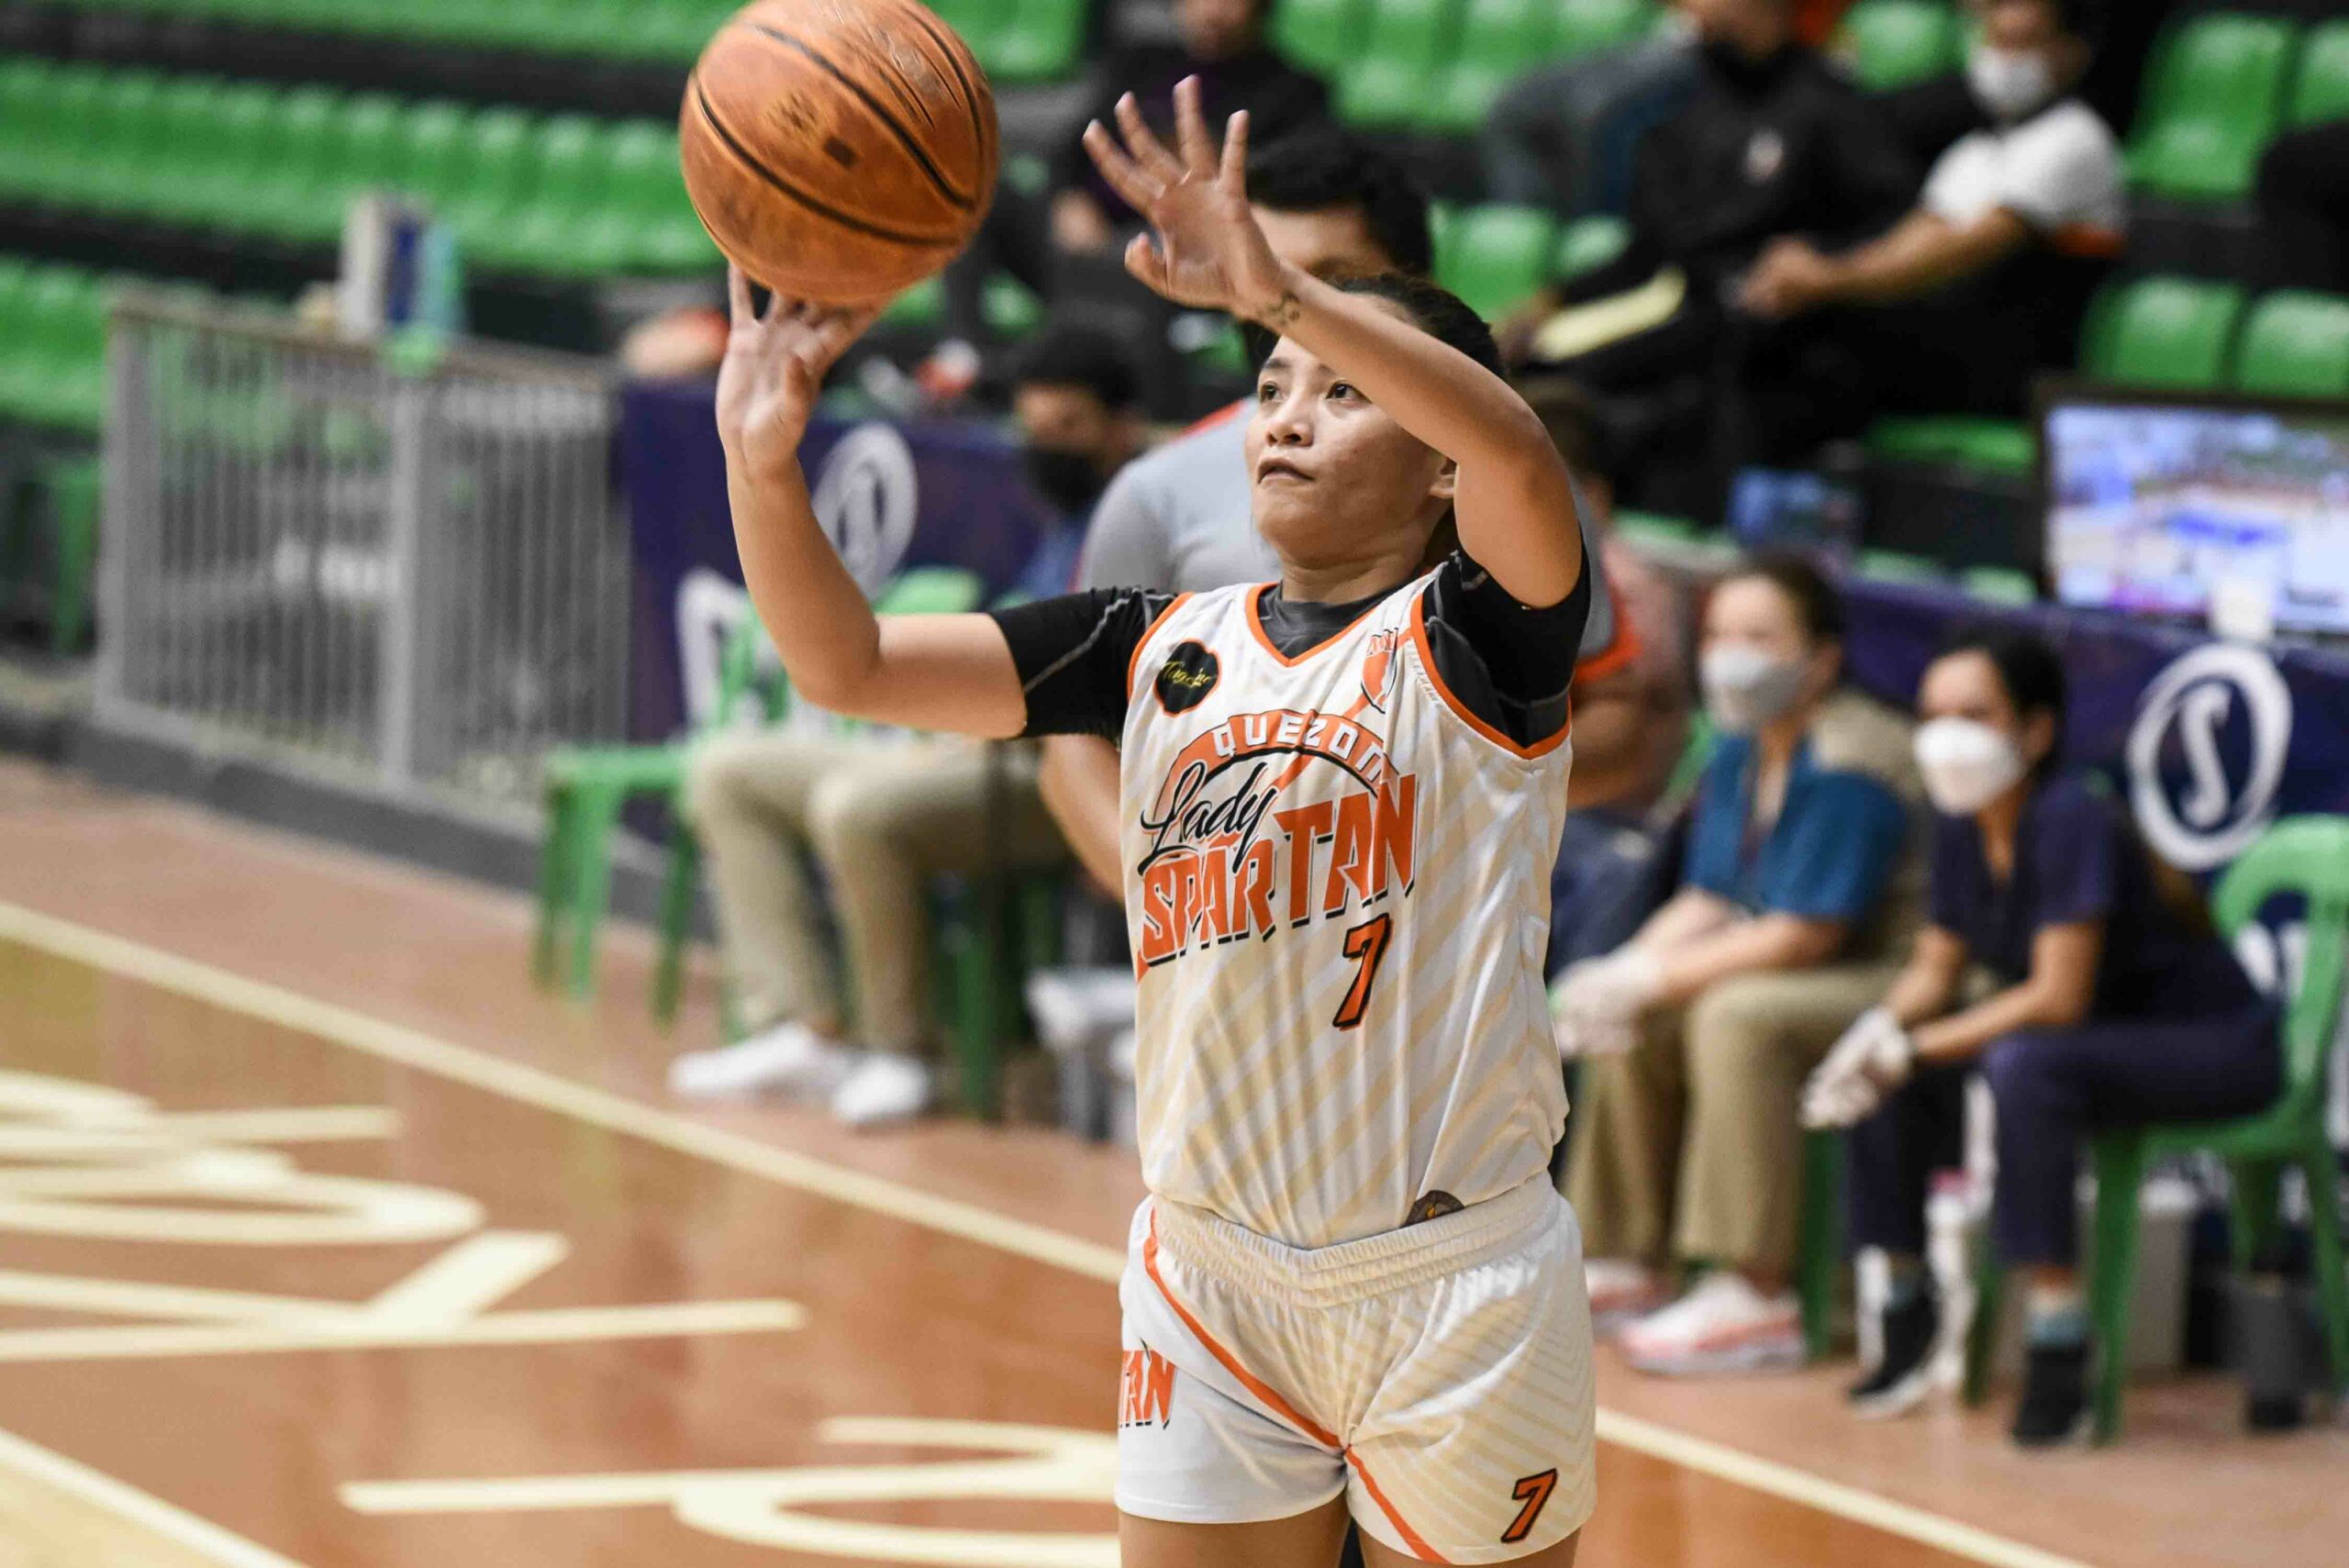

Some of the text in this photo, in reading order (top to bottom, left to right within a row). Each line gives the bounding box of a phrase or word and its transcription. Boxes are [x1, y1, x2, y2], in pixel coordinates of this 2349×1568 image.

[1137, 761, 1278, 877] Lady
[1141, 773, 1419, 968] SPARTAN
[1333, 912, 1394, 1030] 7
[1500, 1468, 1558, 1543] 7
